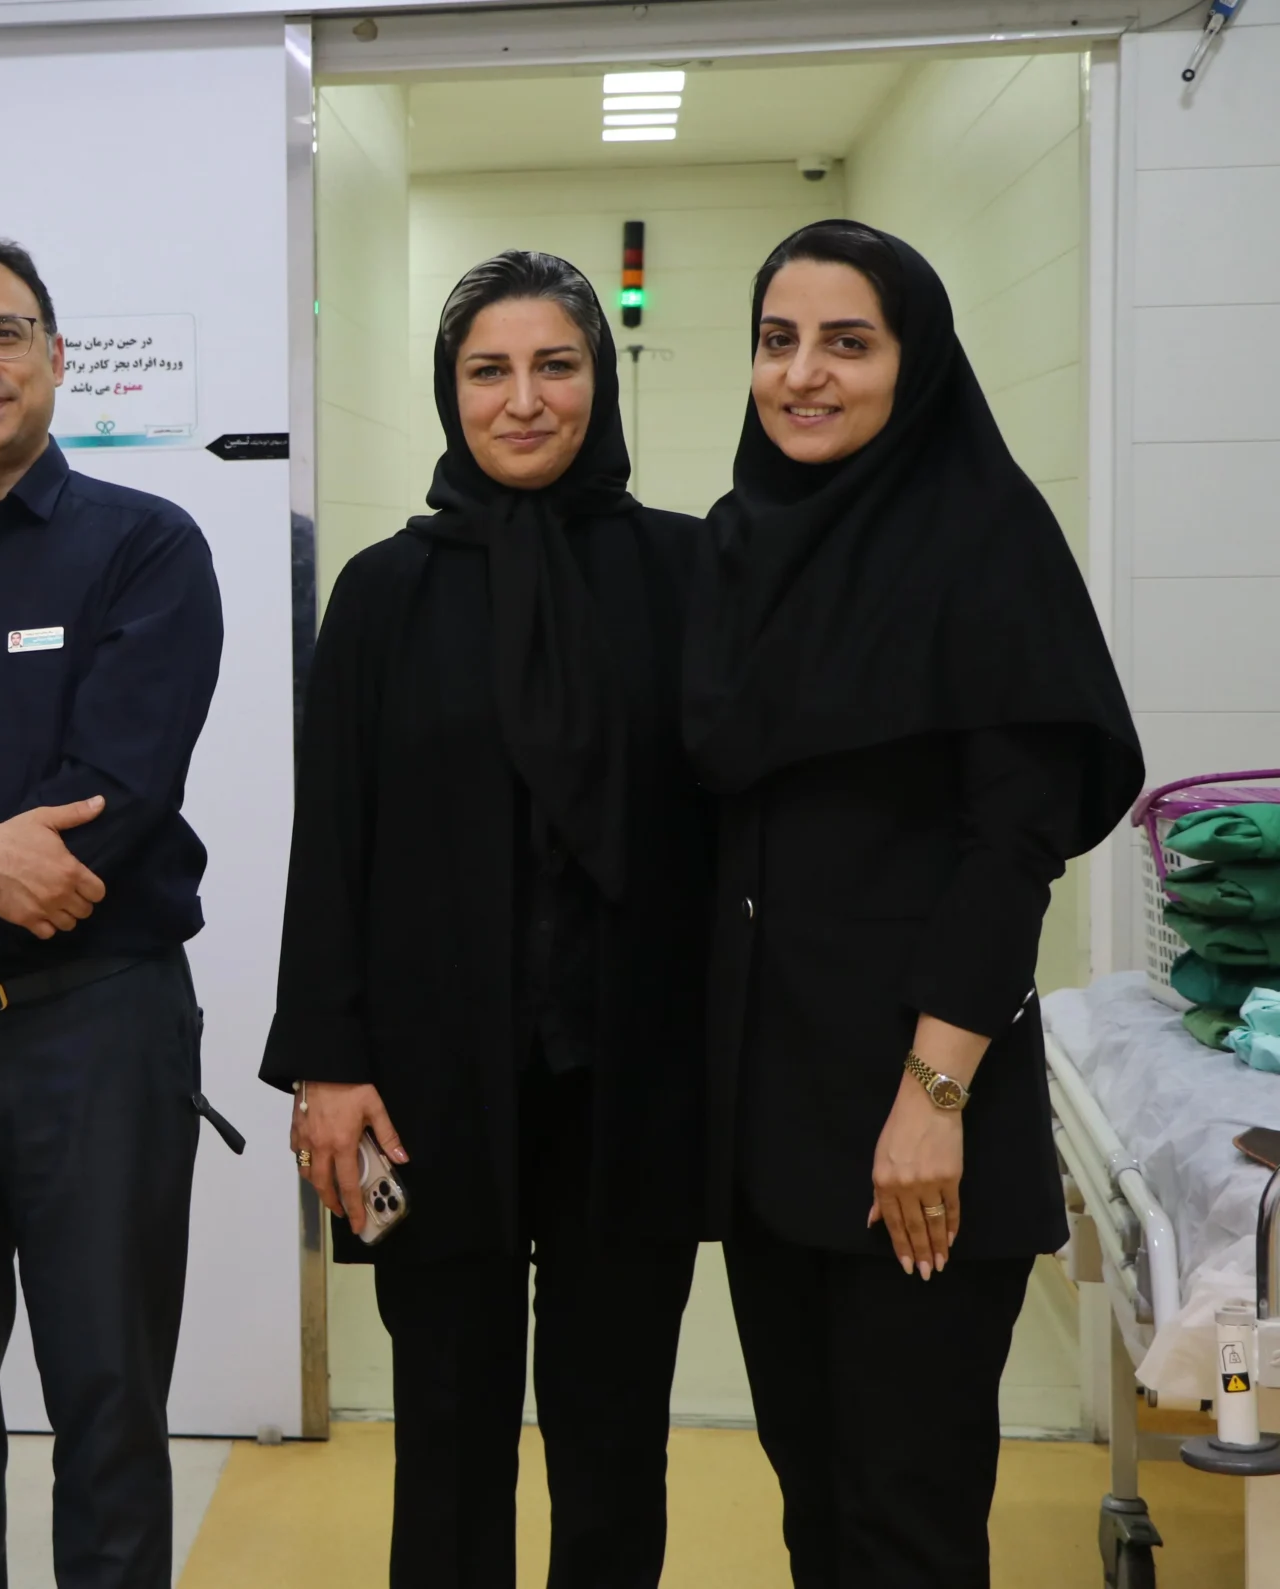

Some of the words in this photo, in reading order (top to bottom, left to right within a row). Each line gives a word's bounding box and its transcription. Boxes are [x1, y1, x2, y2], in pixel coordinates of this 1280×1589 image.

[84, 337, 115, 351] درمان
[116, 338, 137, 350] حین
[140, 336, 153, 349] در
[88, 359, 110, 374] کادر
[113, 361, 130, 373] بجز
[132, 357, 157, 372] افراد
[158, 358, 184, 371] ورود
[70, 382, 93, 394] باشد
[94, 385, 111, 396] می
[113, 382, 143, 395] ممنوع
